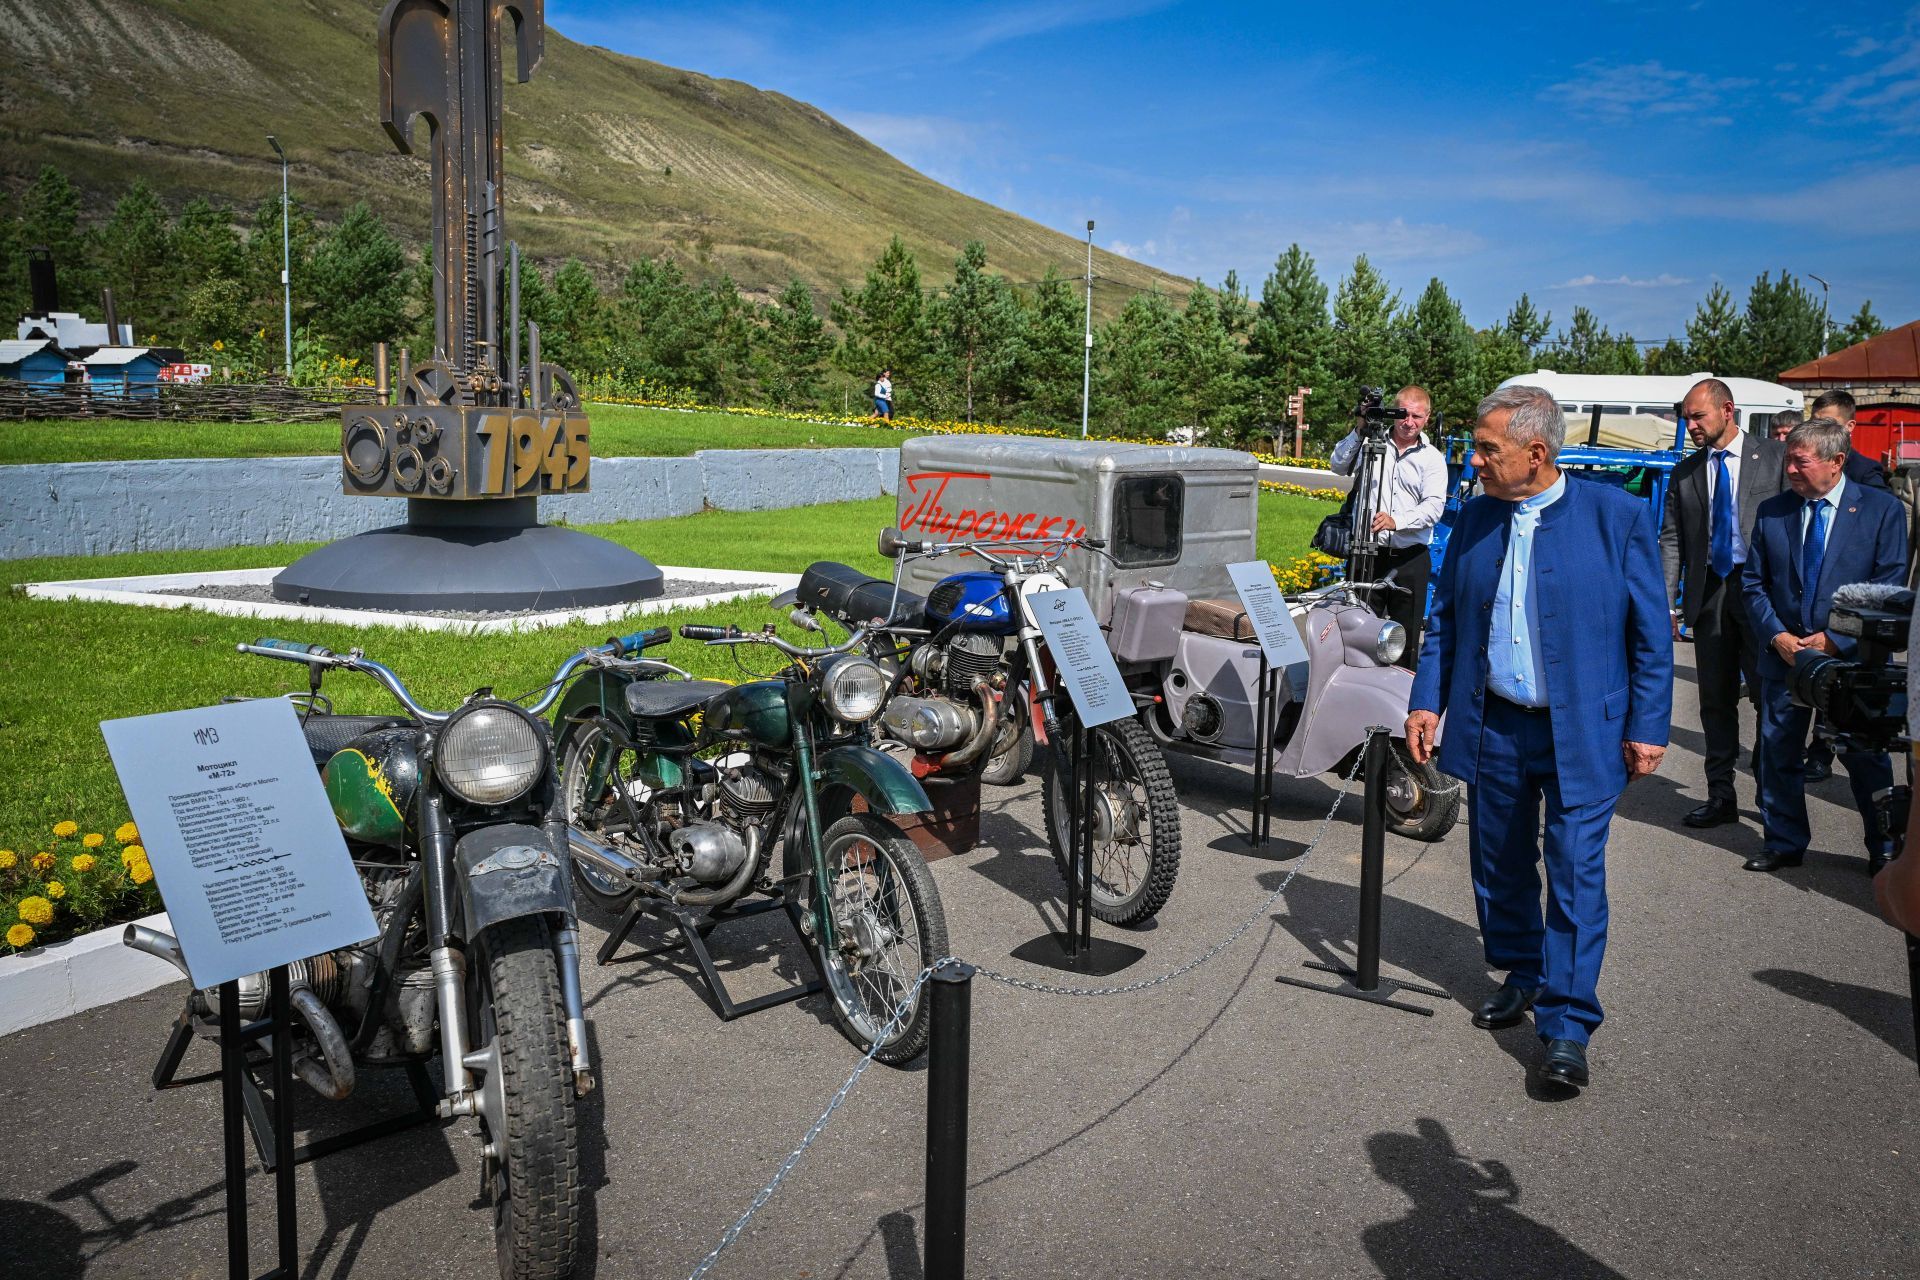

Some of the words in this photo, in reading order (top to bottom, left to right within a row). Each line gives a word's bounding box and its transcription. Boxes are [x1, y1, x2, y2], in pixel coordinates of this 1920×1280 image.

[476, 414, 590, 495] 1945
[901, 472, 1087, 549] Пирожки
[197, 760, 238, 772] Мотоцикл
[208, 769, 236, 779] «М-72»
[190, 797, 207, 805] BMW
[276, 871, 288, 879] 300
